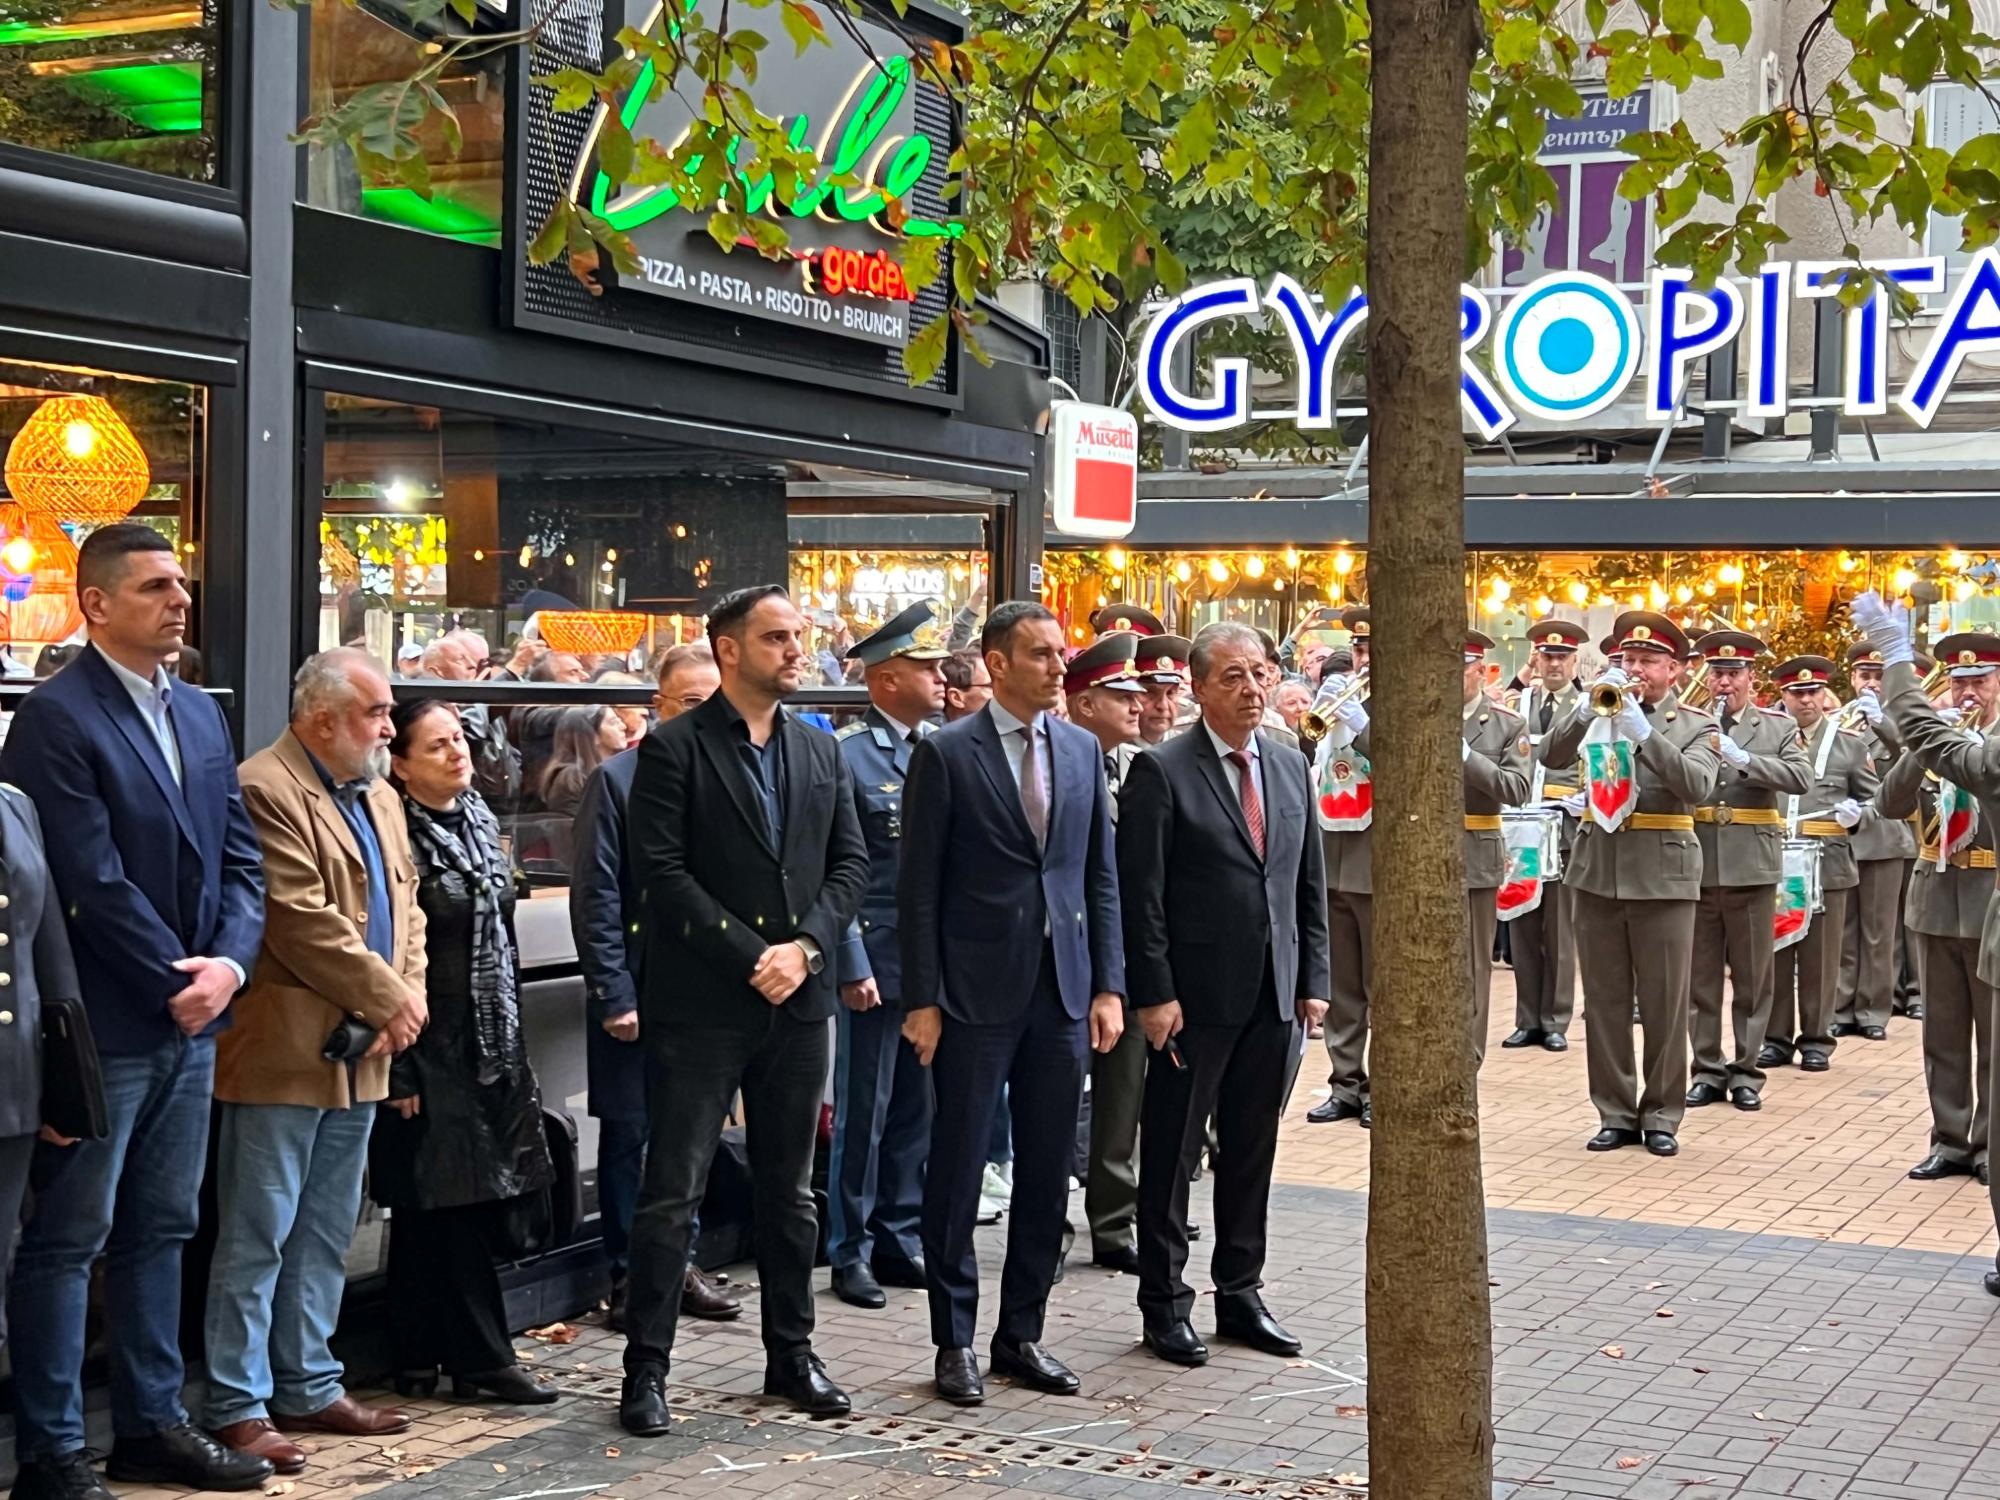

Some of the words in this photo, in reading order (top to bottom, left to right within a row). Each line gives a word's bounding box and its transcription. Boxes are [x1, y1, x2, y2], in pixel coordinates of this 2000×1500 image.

[1541, 127, 1627, 149] ентър
[700, 270, 753, 305] PASTA
[765, 286, 832, 323] RISOTTO
[843, 307, 903, 339] BRUNCH
[1075, 420, 1135, 451] Musetti
